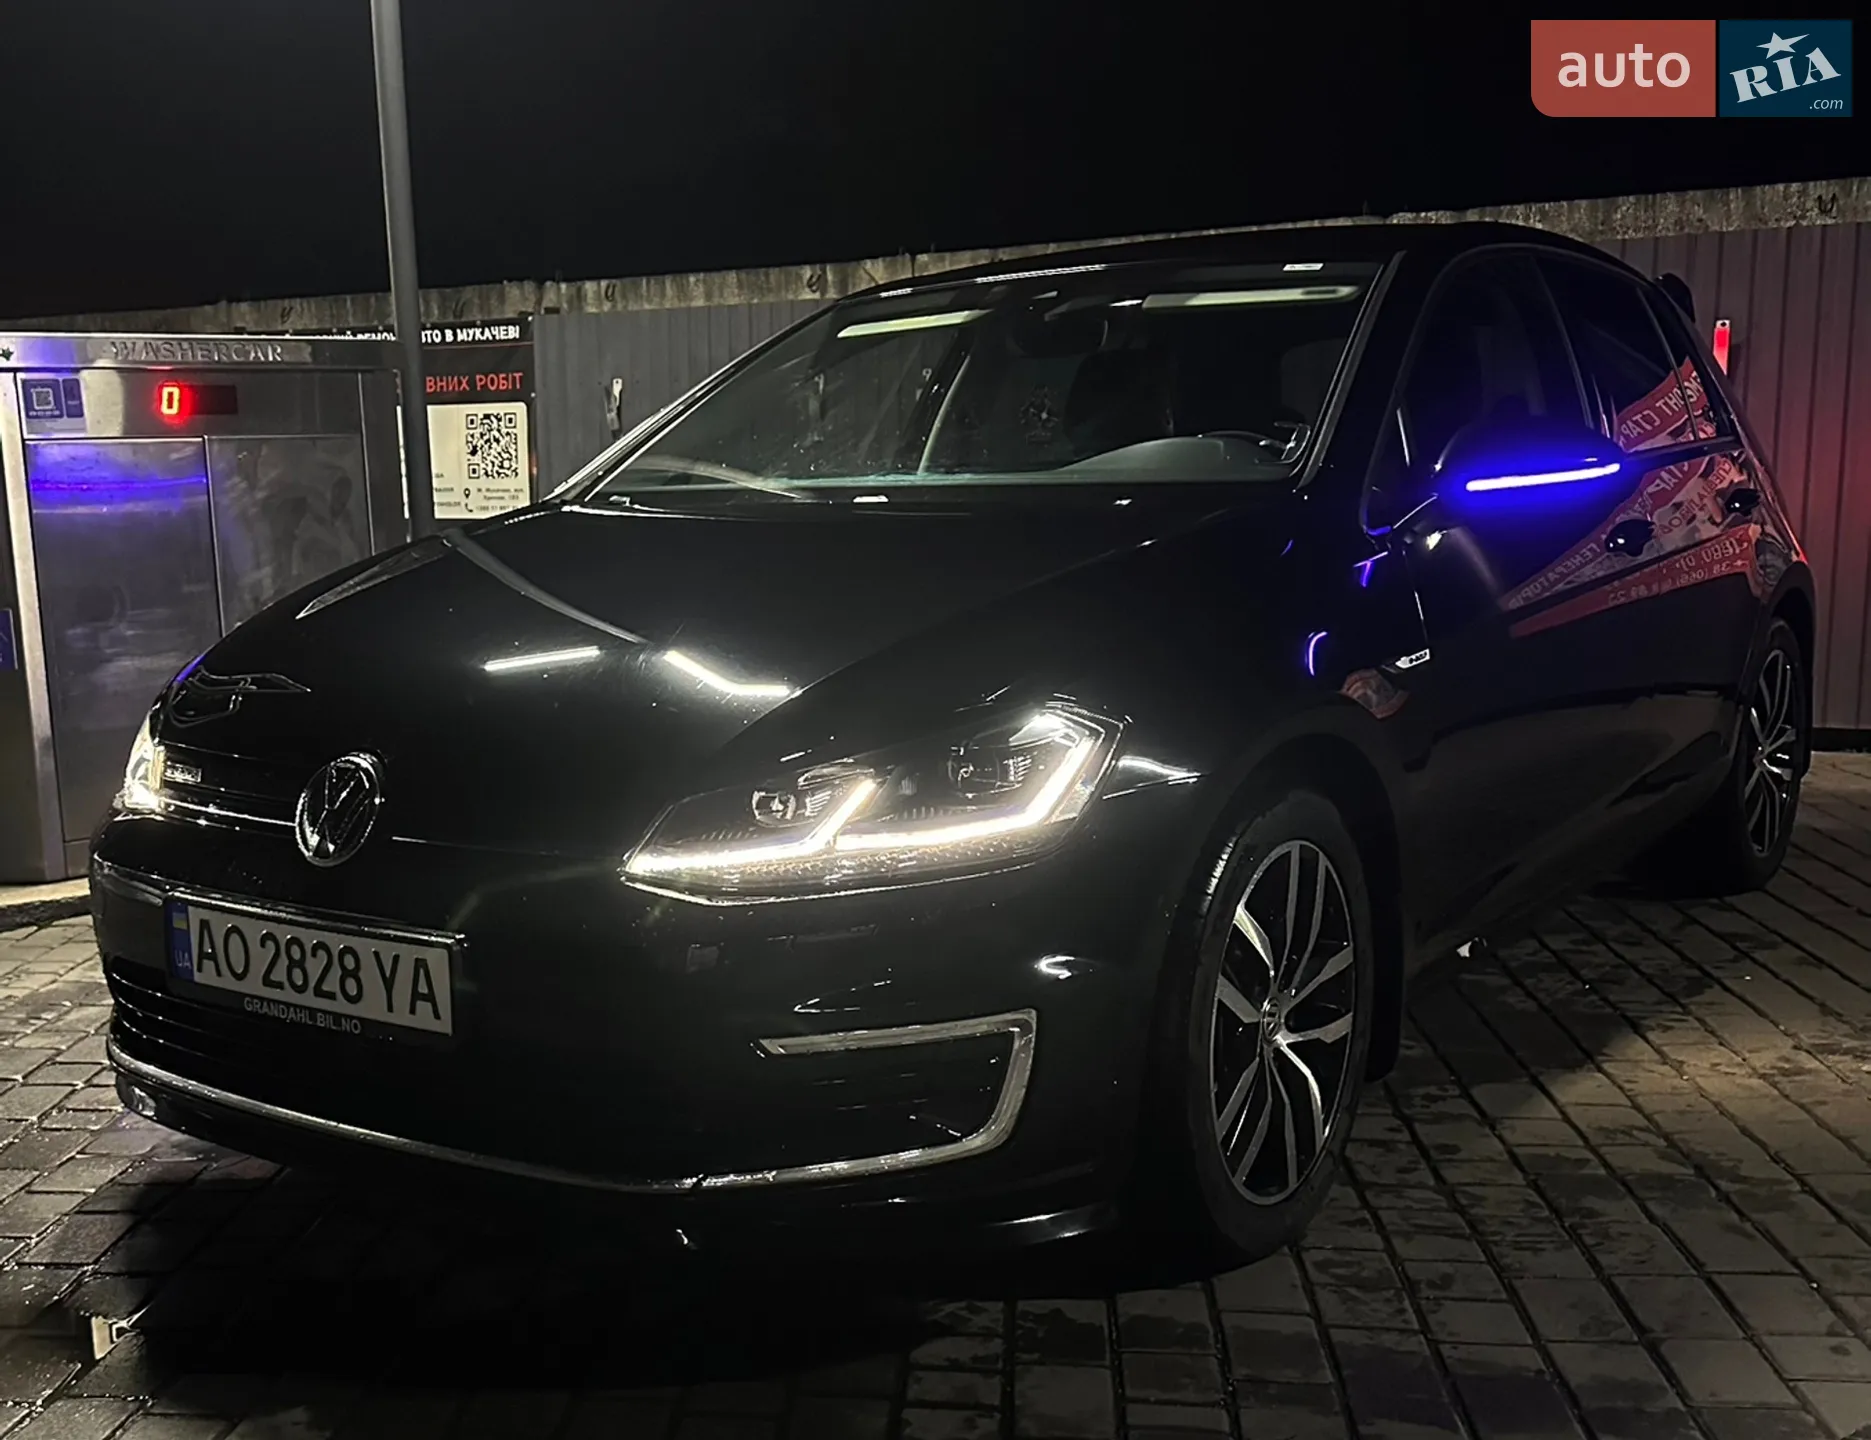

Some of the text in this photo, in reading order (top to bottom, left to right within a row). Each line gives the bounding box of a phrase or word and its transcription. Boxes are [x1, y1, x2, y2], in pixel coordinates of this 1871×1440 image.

[444, 328, 454, 343] В
[456, 325, 520, 342] МУКАЧЕВІ
[112, 341, 284, 362] WASHERCAR
[475, 371, 524, 391] РОБІТ
[160, 386, 180, 415] 0
[174, 948, 192, 968] UA
[196, 918, 442, 1021] AO 2828 YA
